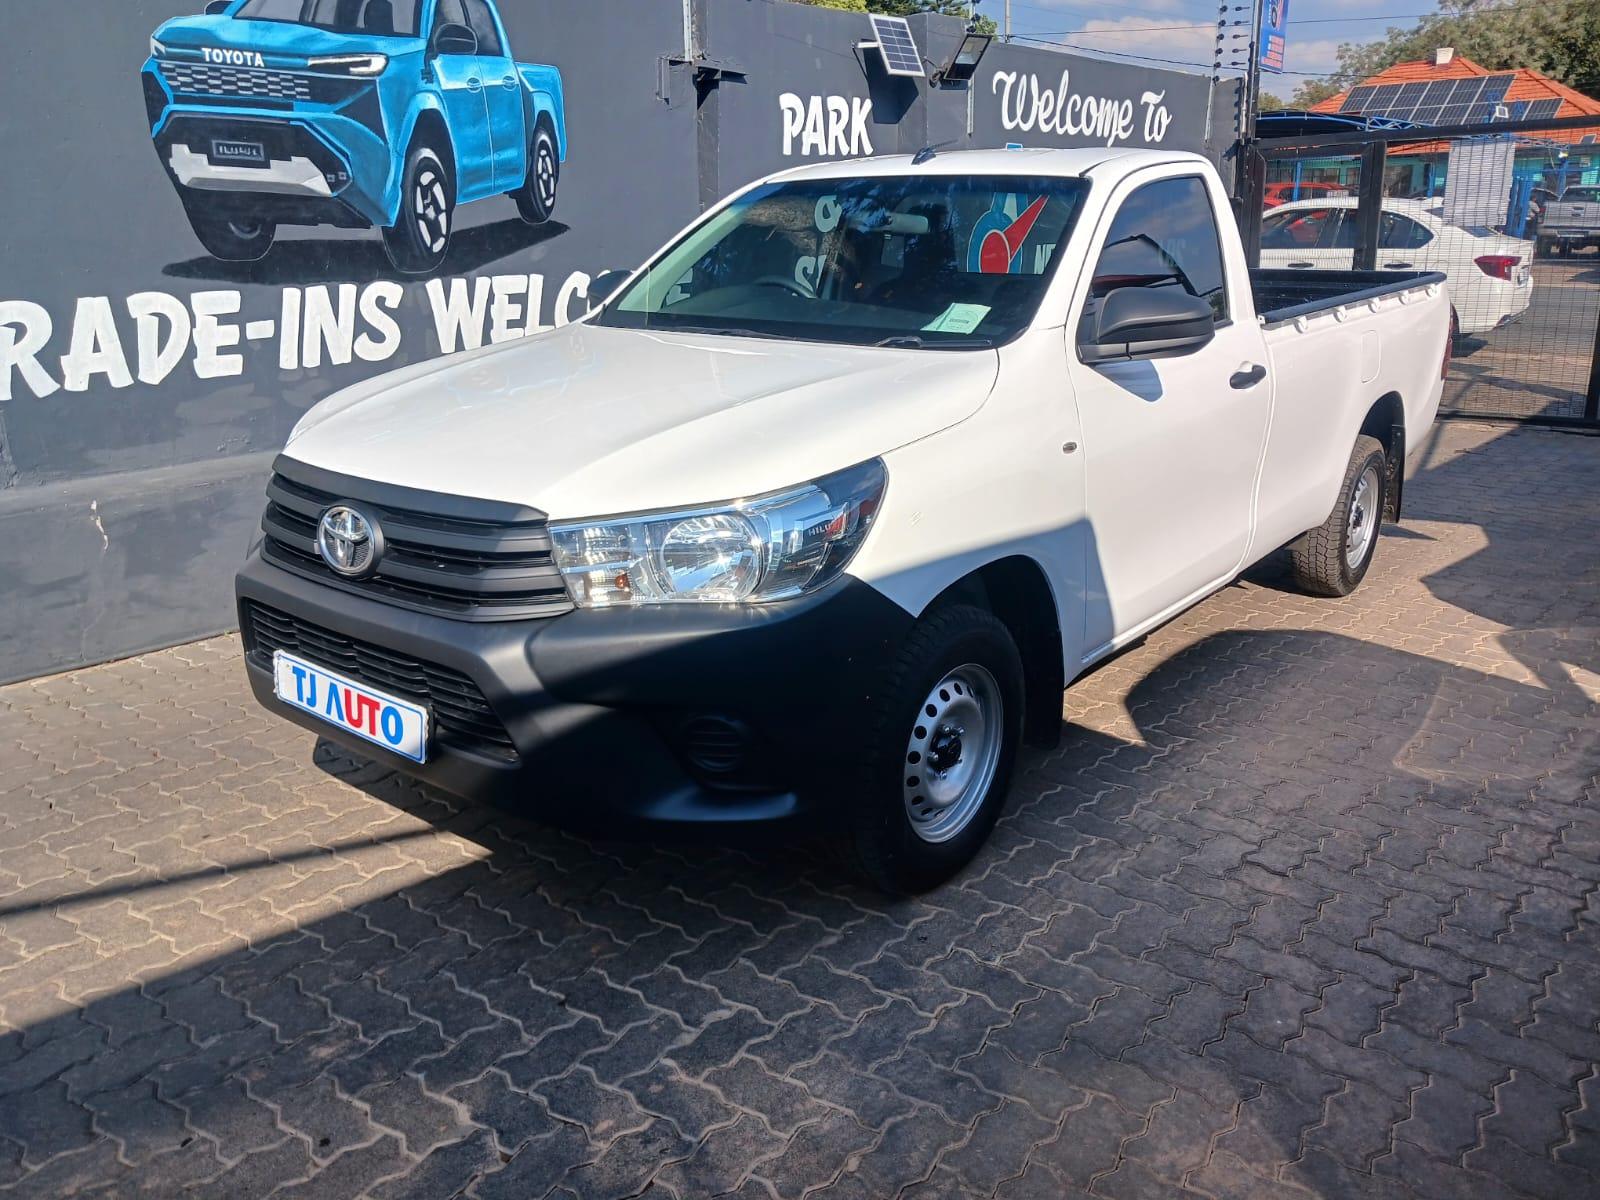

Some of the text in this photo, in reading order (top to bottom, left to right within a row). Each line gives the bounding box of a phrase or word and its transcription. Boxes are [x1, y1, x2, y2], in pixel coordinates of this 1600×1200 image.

[201, 47, 265, 68] TOYOTA
[779, 92, 874, 156] PARK
[987, 69, 1173, 148] Welcome To
[425, 270, 610, 354] WELC
[292, 665, 404, 746] TJ AUTO
